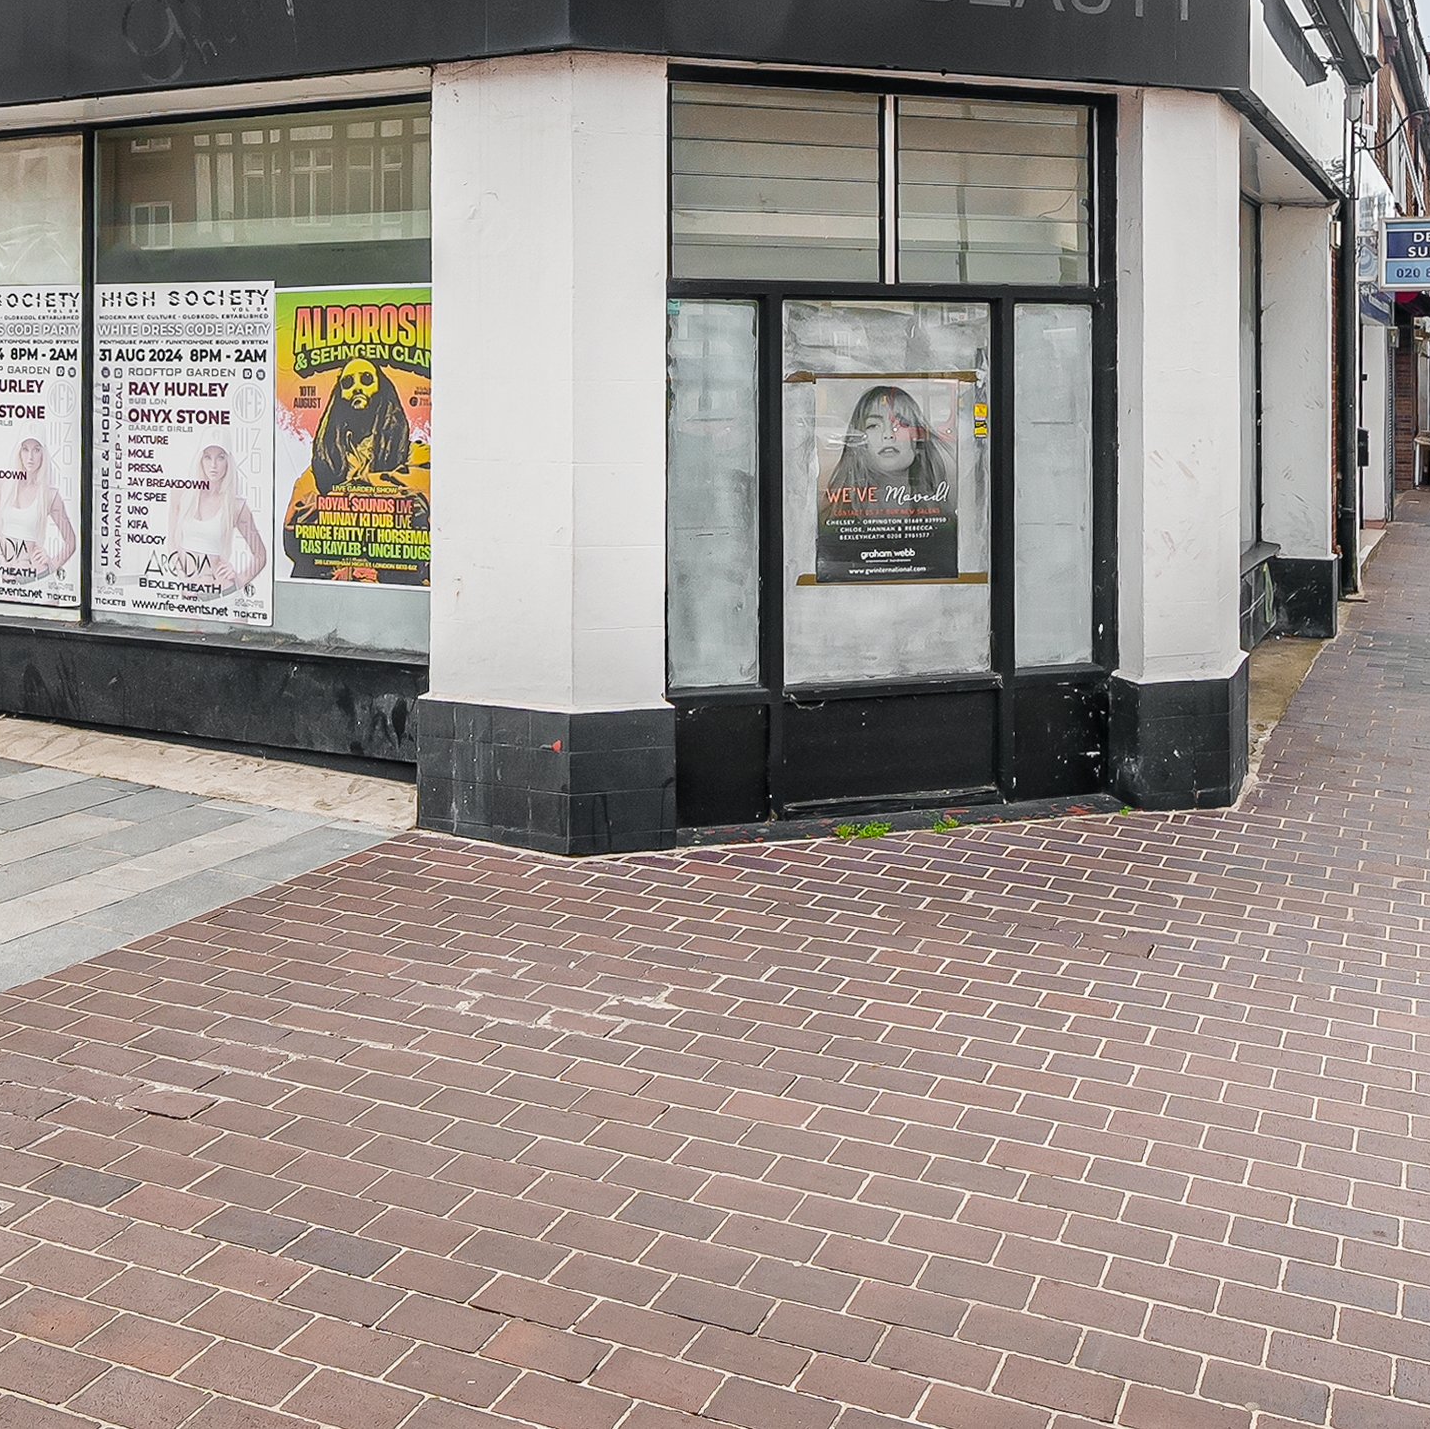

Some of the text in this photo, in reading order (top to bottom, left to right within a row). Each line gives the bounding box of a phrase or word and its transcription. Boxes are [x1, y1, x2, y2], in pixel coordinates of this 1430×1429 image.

[1396, 267, 1420, 278] 020
[101, 289, 269, 307] HIGH SOCIETY
[6, 324, 40, 336] CODE
[42, 324, 80, 336] PARTY
[98, 323, 270, 337] WHITE DRESS CODE PARTY
[11, 348, 38, 360] 8PM
[50, 348, 77, 361] 2AM
[99, 349, 267, 362] 31 AUG 2024 8PM 2AM
[295, 352, 308, 371] &
[7, 366, 51, 374] GARDEN
[128, 368, 236, 377] ROOFTOP GARDEN
[128, 382, 229, 397] RAY HURLEY
[299, 386, 316, 397] 10TH
[293, 397, 321, 409] AUGUST
[128, 409, 230, 425] ONYX STONE
[128, 435, 169, 445] MIXTURE
[128, 449, 154, 459] MOLE
[101, 383, 110, 566] UK GARAGE HOUSE
[128, 463, 164, 473] PRESSA
[127, 477, 210, 490] JAY BREAKDOWN
[127, 492, 143, 501] MC
[826, 481, 950, 505] WE'VE Moved!
[127, 506, 149, 515] UNO
[318, 496, 413, 514] ROYAL SOUNDS LIVE
[127, 520, 149, 530] KIFA
[319, 511, 412, 529] MUNAY KI DUB LIVE
[127, 534, 166, 545] NOLOGY
[295, 525, 431, 545] PRINCE FATTY FT HORSEMA
[301, 540, 431, 560] RAS KAYLEB UNCLE DUGS
[860, 548, 916, 560] graham webb
[139, 577, 222, 594] BEXLEYHEATH
[131, 600, 229, 617] www.nfe-events.net
